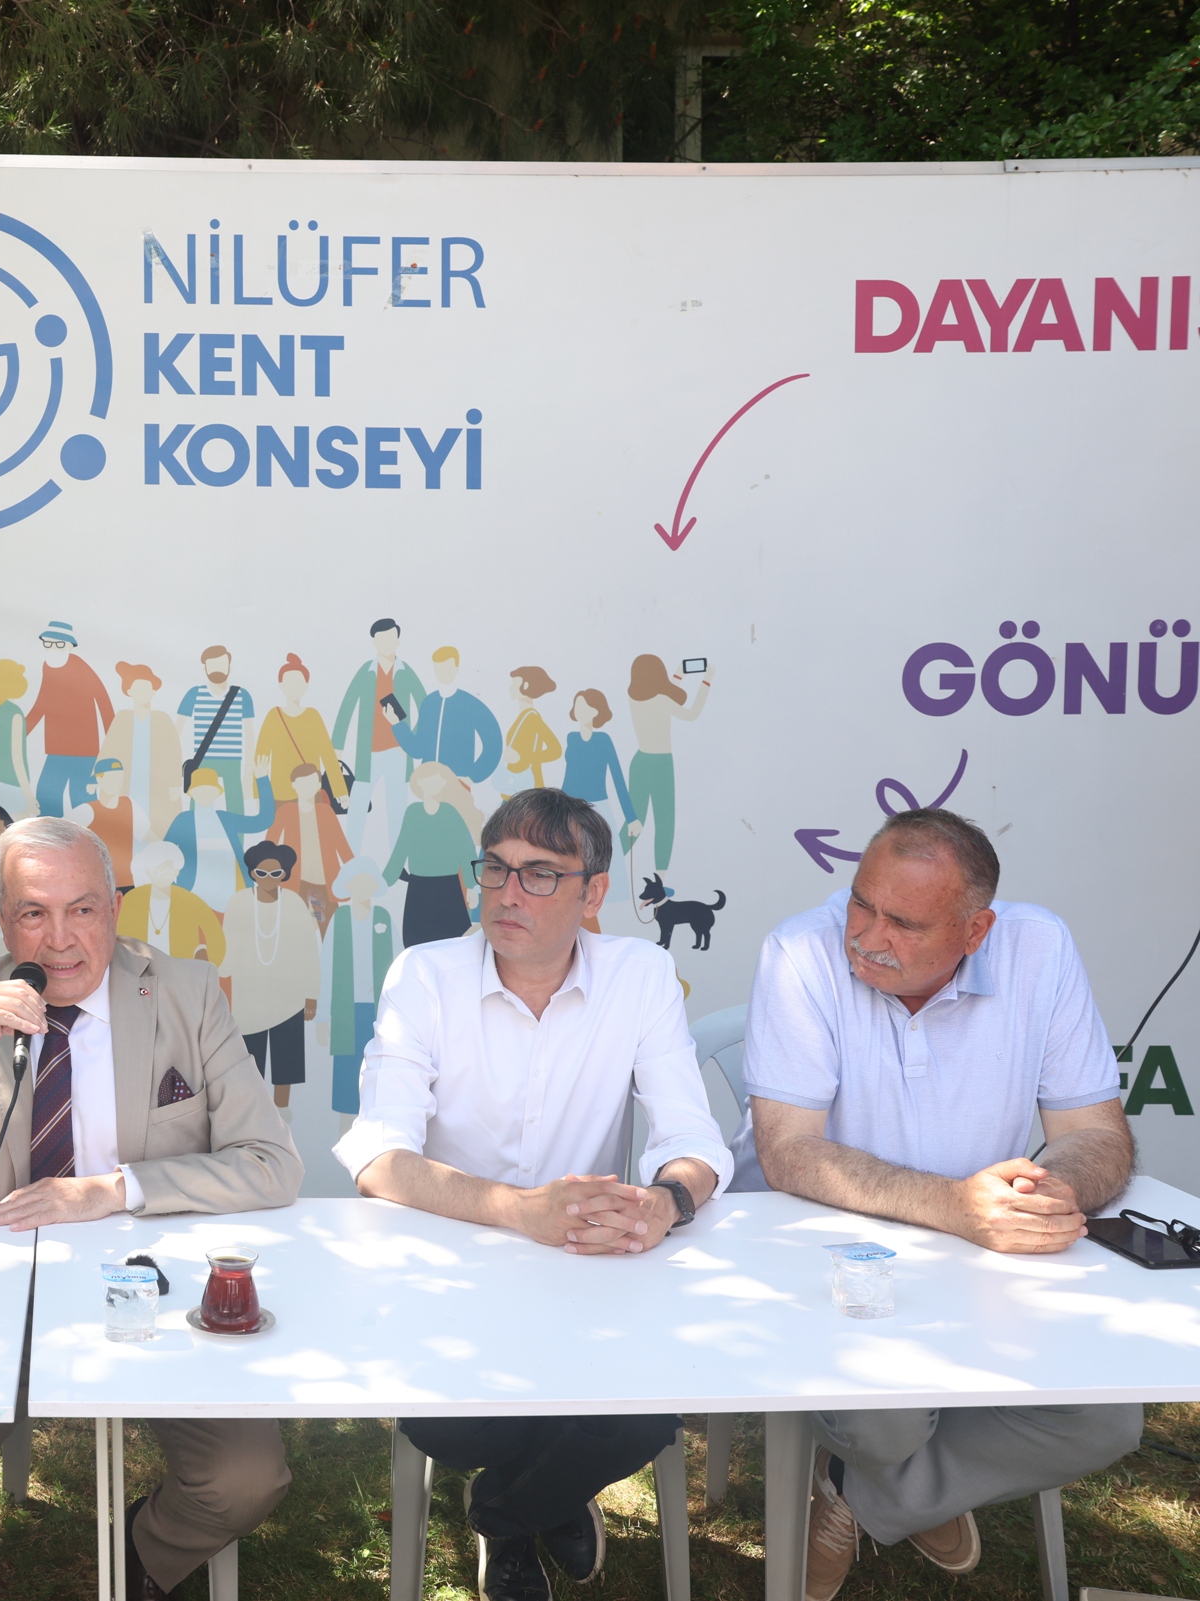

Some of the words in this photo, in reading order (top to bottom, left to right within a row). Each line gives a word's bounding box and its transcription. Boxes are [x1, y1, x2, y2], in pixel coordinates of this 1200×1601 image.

[143, 218, 486, 309] NİLÜFER
[854, 275, 1200, 354] DAYANI
[143, 332, 345, 398] KENT
[143, 408, 482, 490] KONSEYİ
[901, 618, 1200, 717] GÖNÜ
